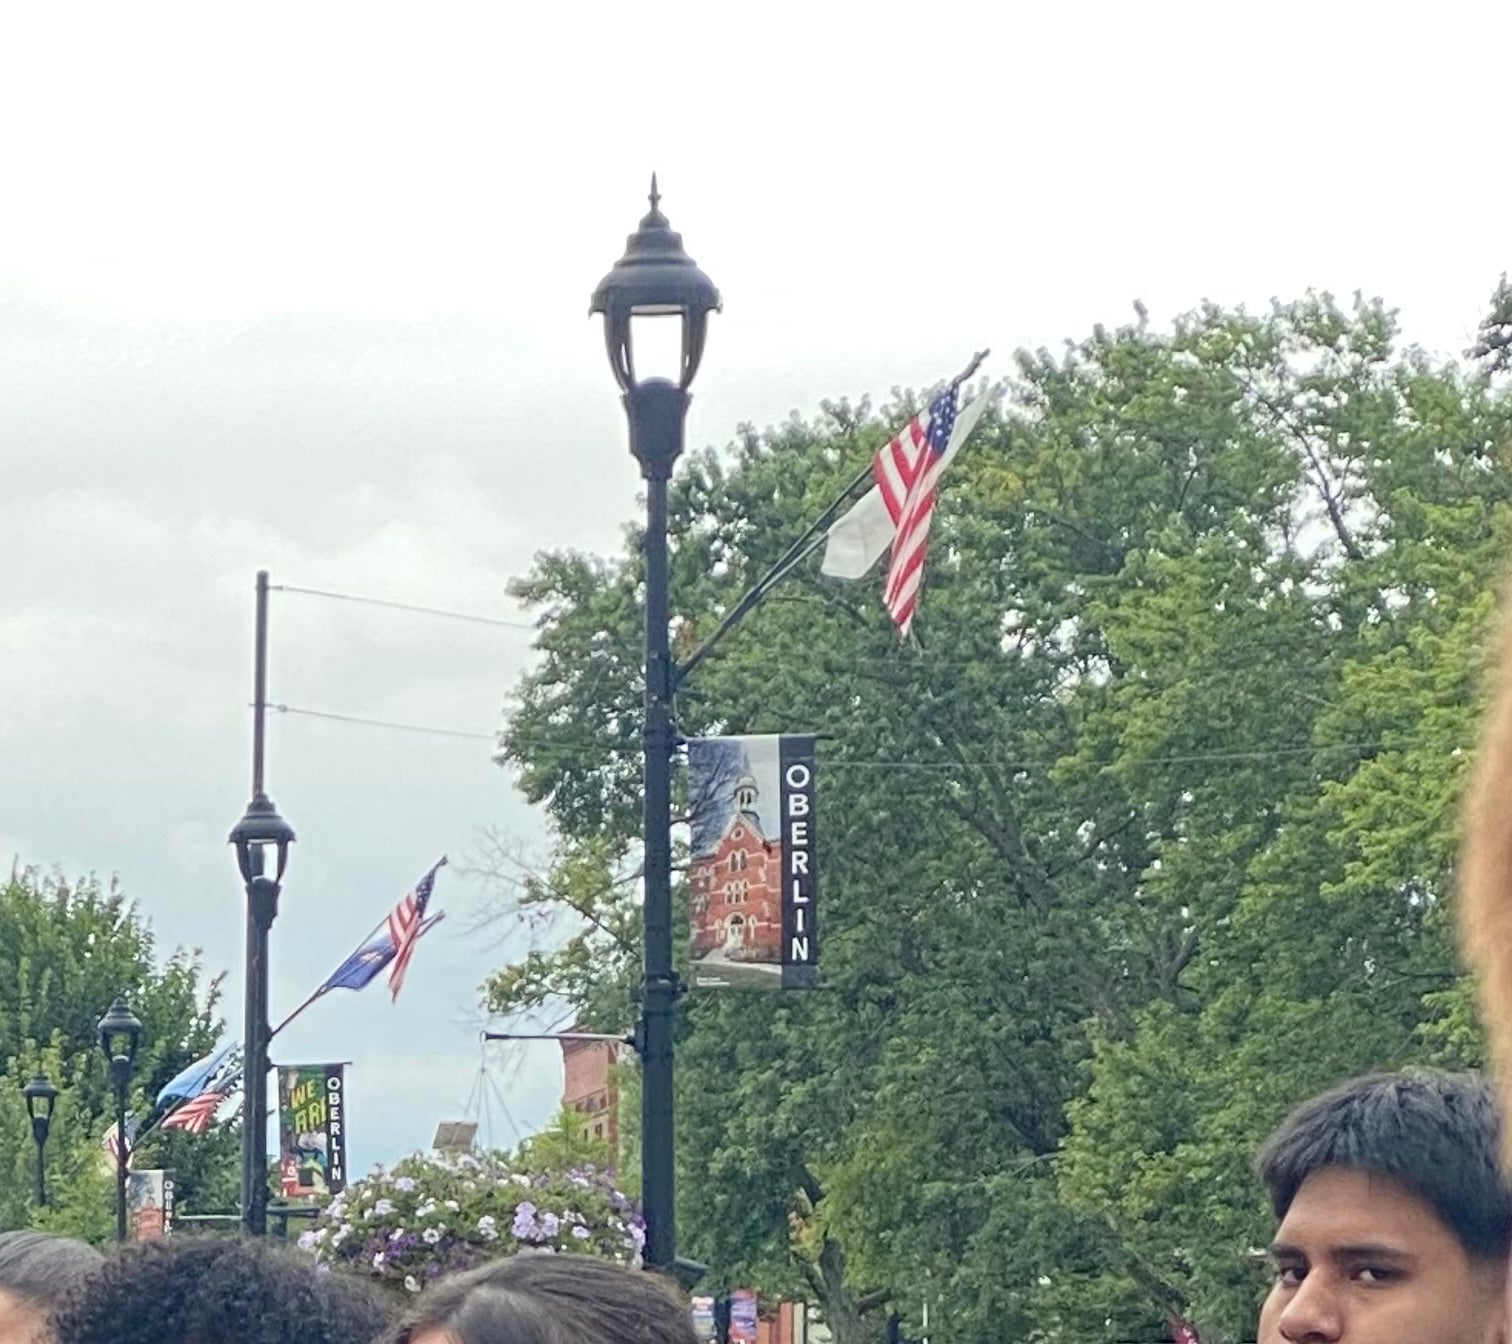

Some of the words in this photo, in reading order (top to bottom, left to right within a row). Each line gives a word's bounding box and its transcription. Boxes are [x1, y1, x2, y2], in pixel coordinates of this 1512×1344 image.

[785, 763, 810, 961] OBERLIN
[291, 1079, 316, 1109] WE
[326, 1077, 341, 1180] OBERLIN
